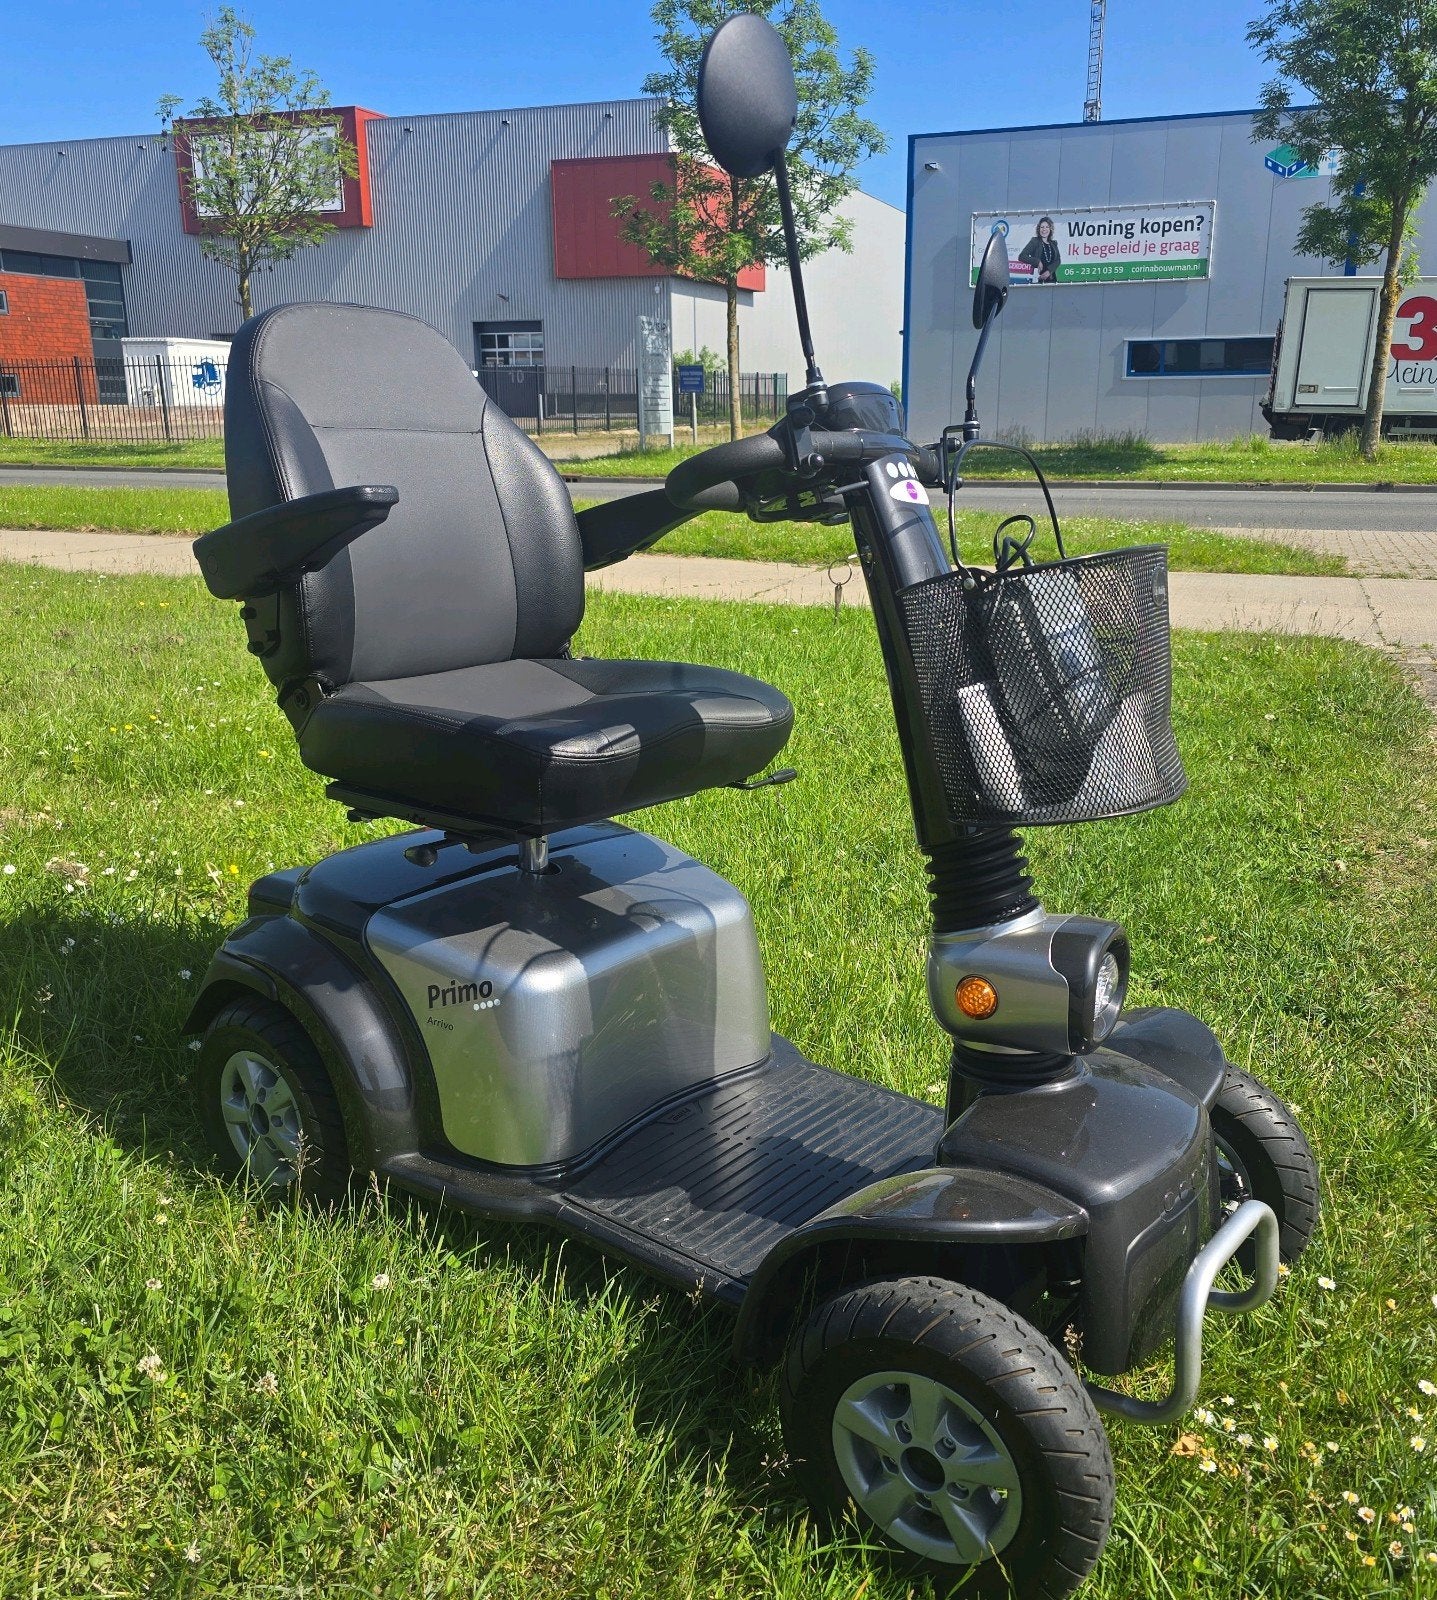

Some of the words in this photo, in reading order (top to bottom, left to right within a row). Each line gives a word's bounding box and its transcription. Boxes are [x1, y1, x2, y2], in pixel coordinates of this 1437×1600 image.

[1068, 220, 1135, 239] Woning
[1140, 215, 1205, 237] kopen?
[1068, 244, 1079, 256] Ik
[1083, 241, 1140, 257] begeleid
[1143, 242, 1156, 256] je
[1160, 241, 1200, 255] graag
[1064, 268, 1075, 276] 06
[1131, 264, 1201, 273] corinabouwman.nl
[509, 370, 525, 384] 10
[427, 980, 493, 1009] Primo
[427, 1016, 454, 1031] Arrivo
